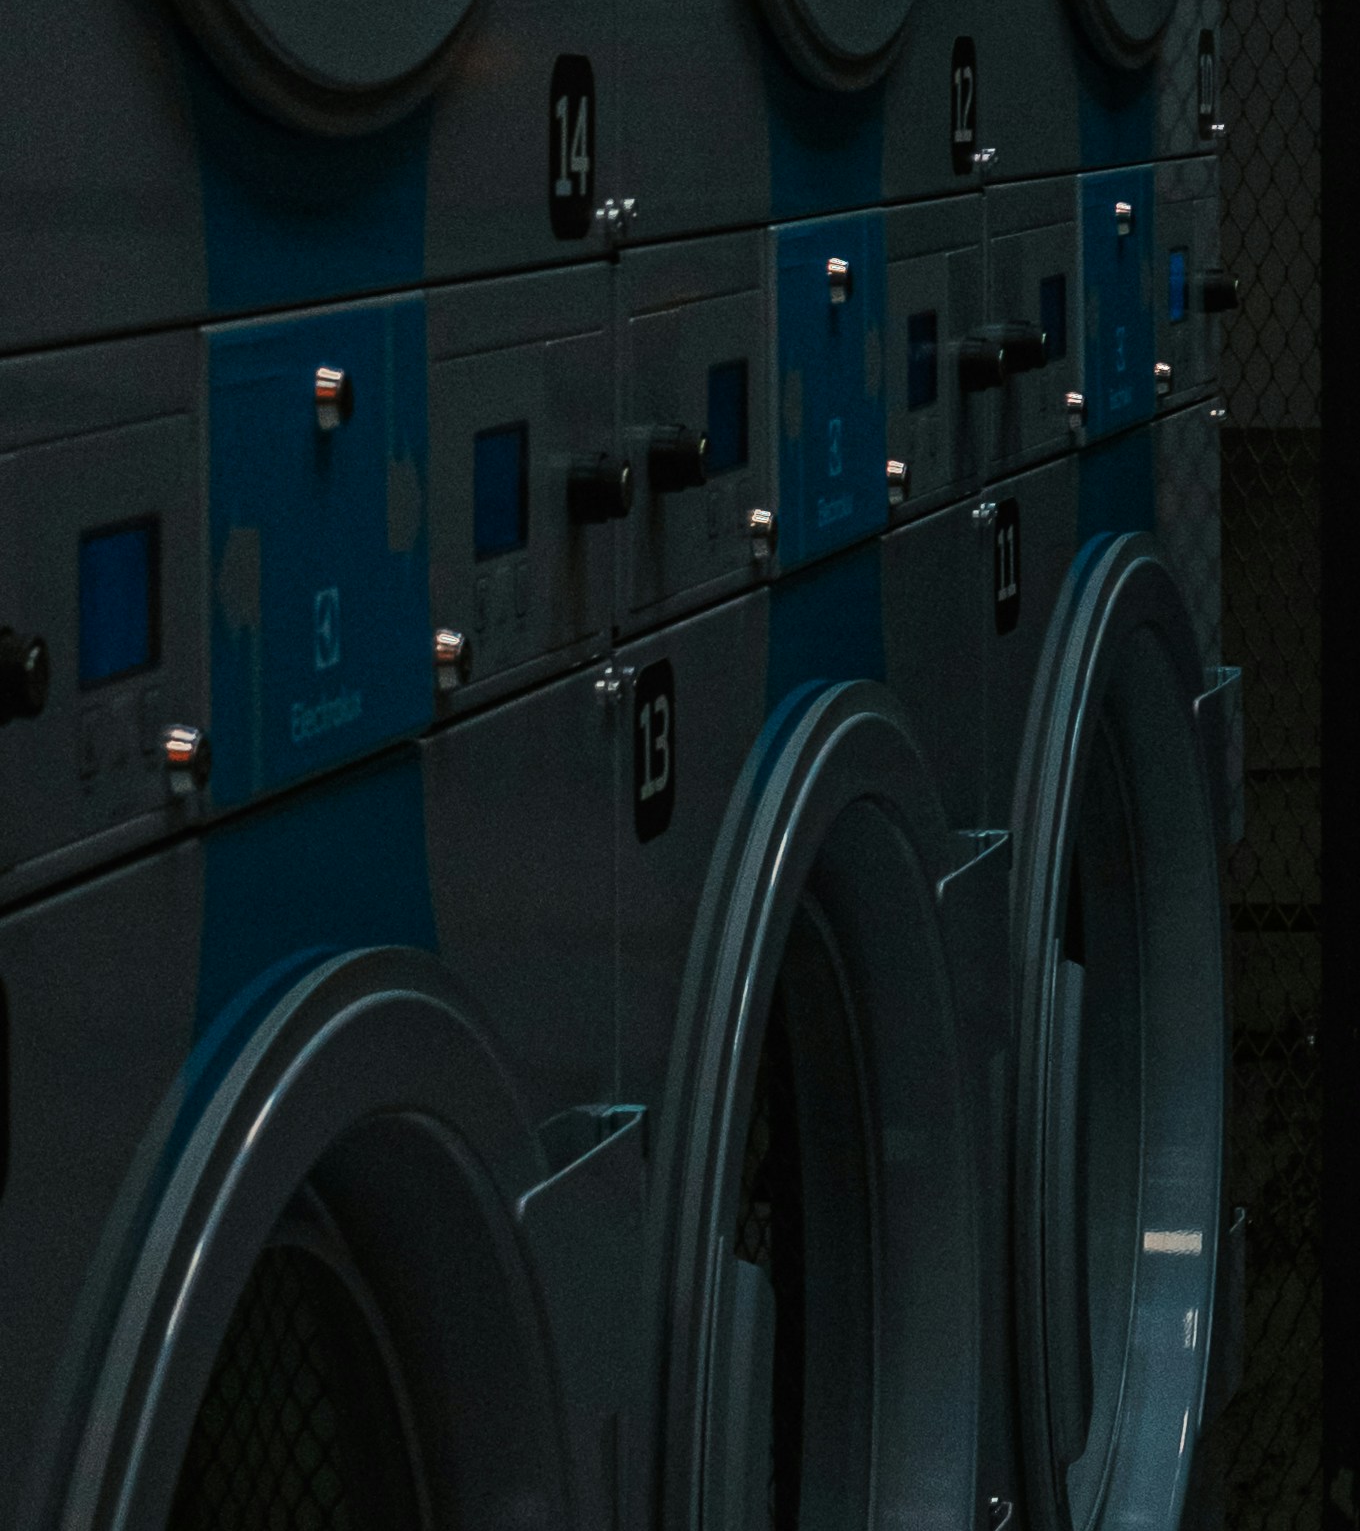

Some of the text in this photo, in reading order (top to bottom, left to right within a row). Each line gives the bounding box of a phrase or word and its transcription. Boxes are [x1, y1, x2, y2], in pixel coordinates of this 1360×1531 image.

[553, 93, 591, 198] 14
[953, 64, 975, 144] 12
[996, 528, 1018, 601] 11
[638, 694, 672, 803] 13
